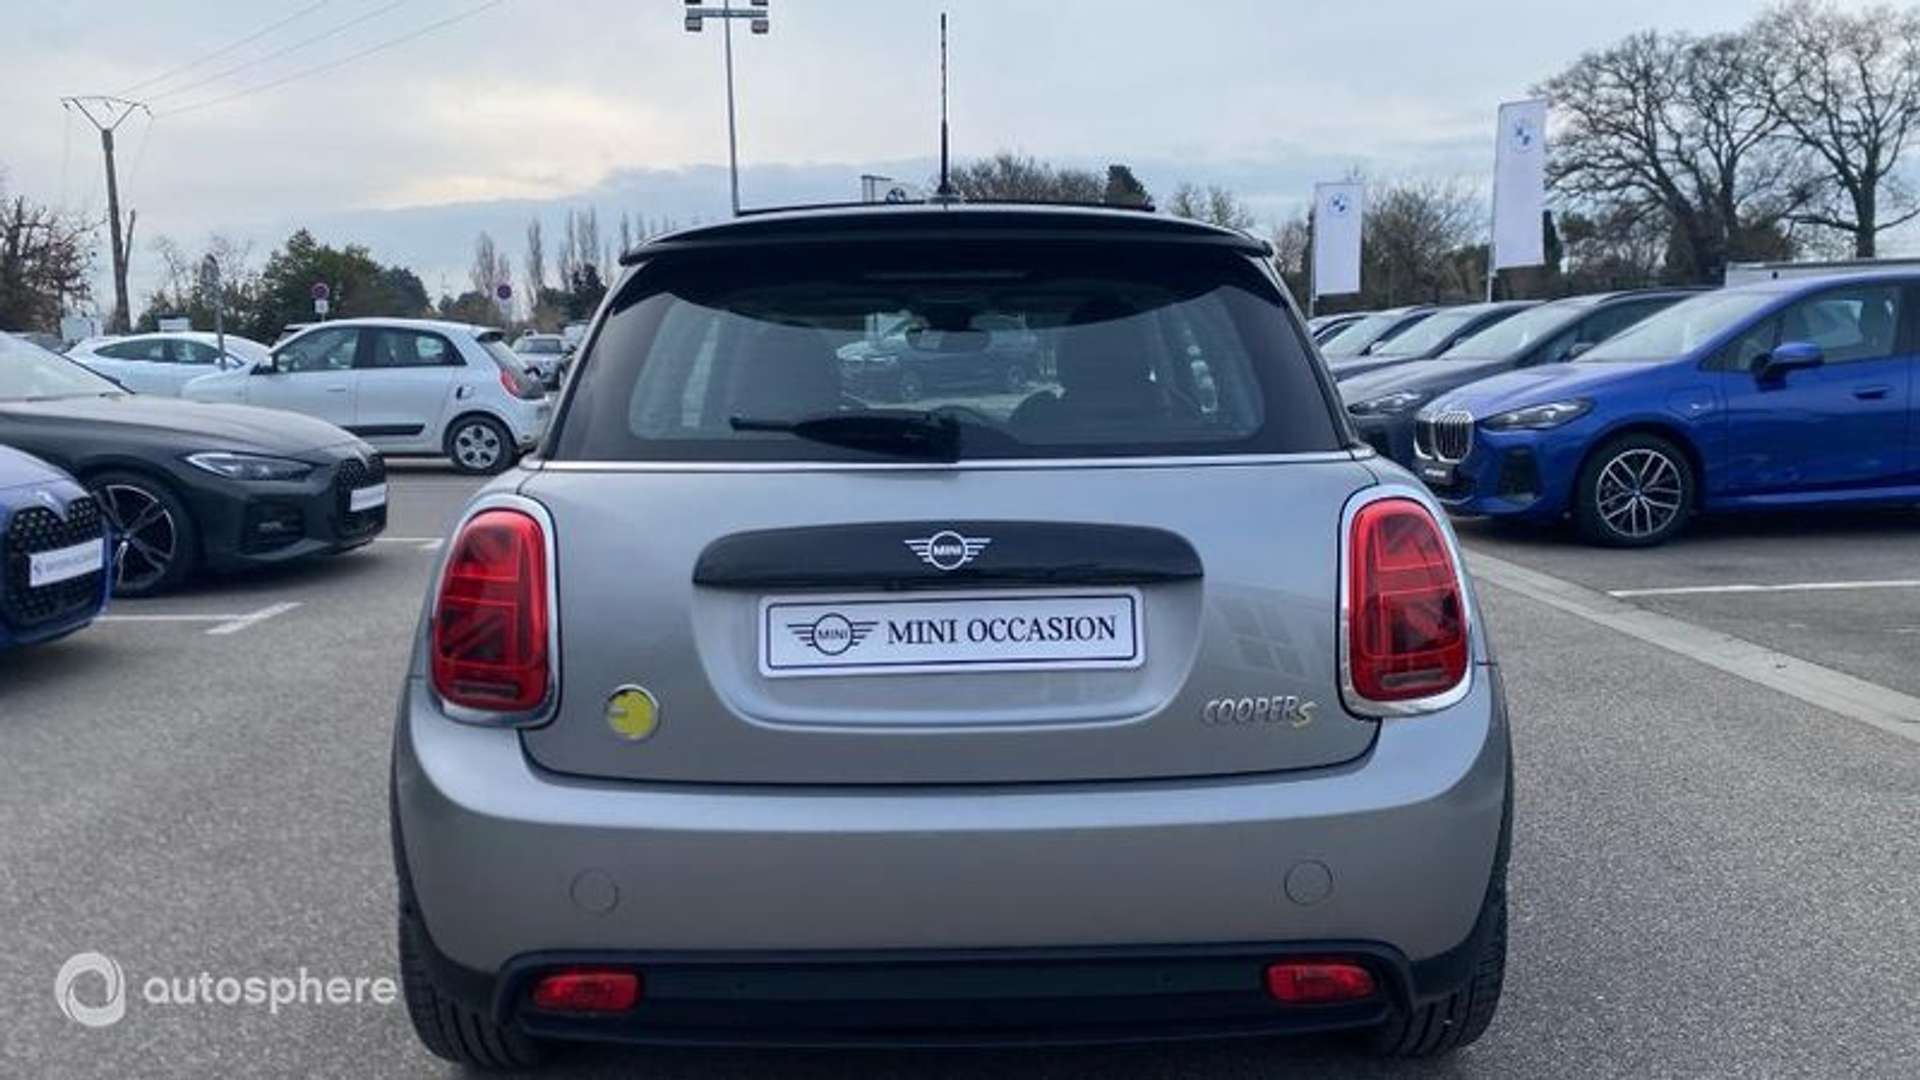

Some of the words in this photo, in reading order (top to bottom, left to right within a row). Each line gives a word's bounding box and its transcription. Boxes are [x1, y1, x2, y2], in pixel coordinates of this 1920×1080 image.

[933, 545, 961, 556] MINI
[818, 628, 849, 640] MINI
[887, 619, 958, 645] MINI
[967, 614, 1118, 643] OCCASION
